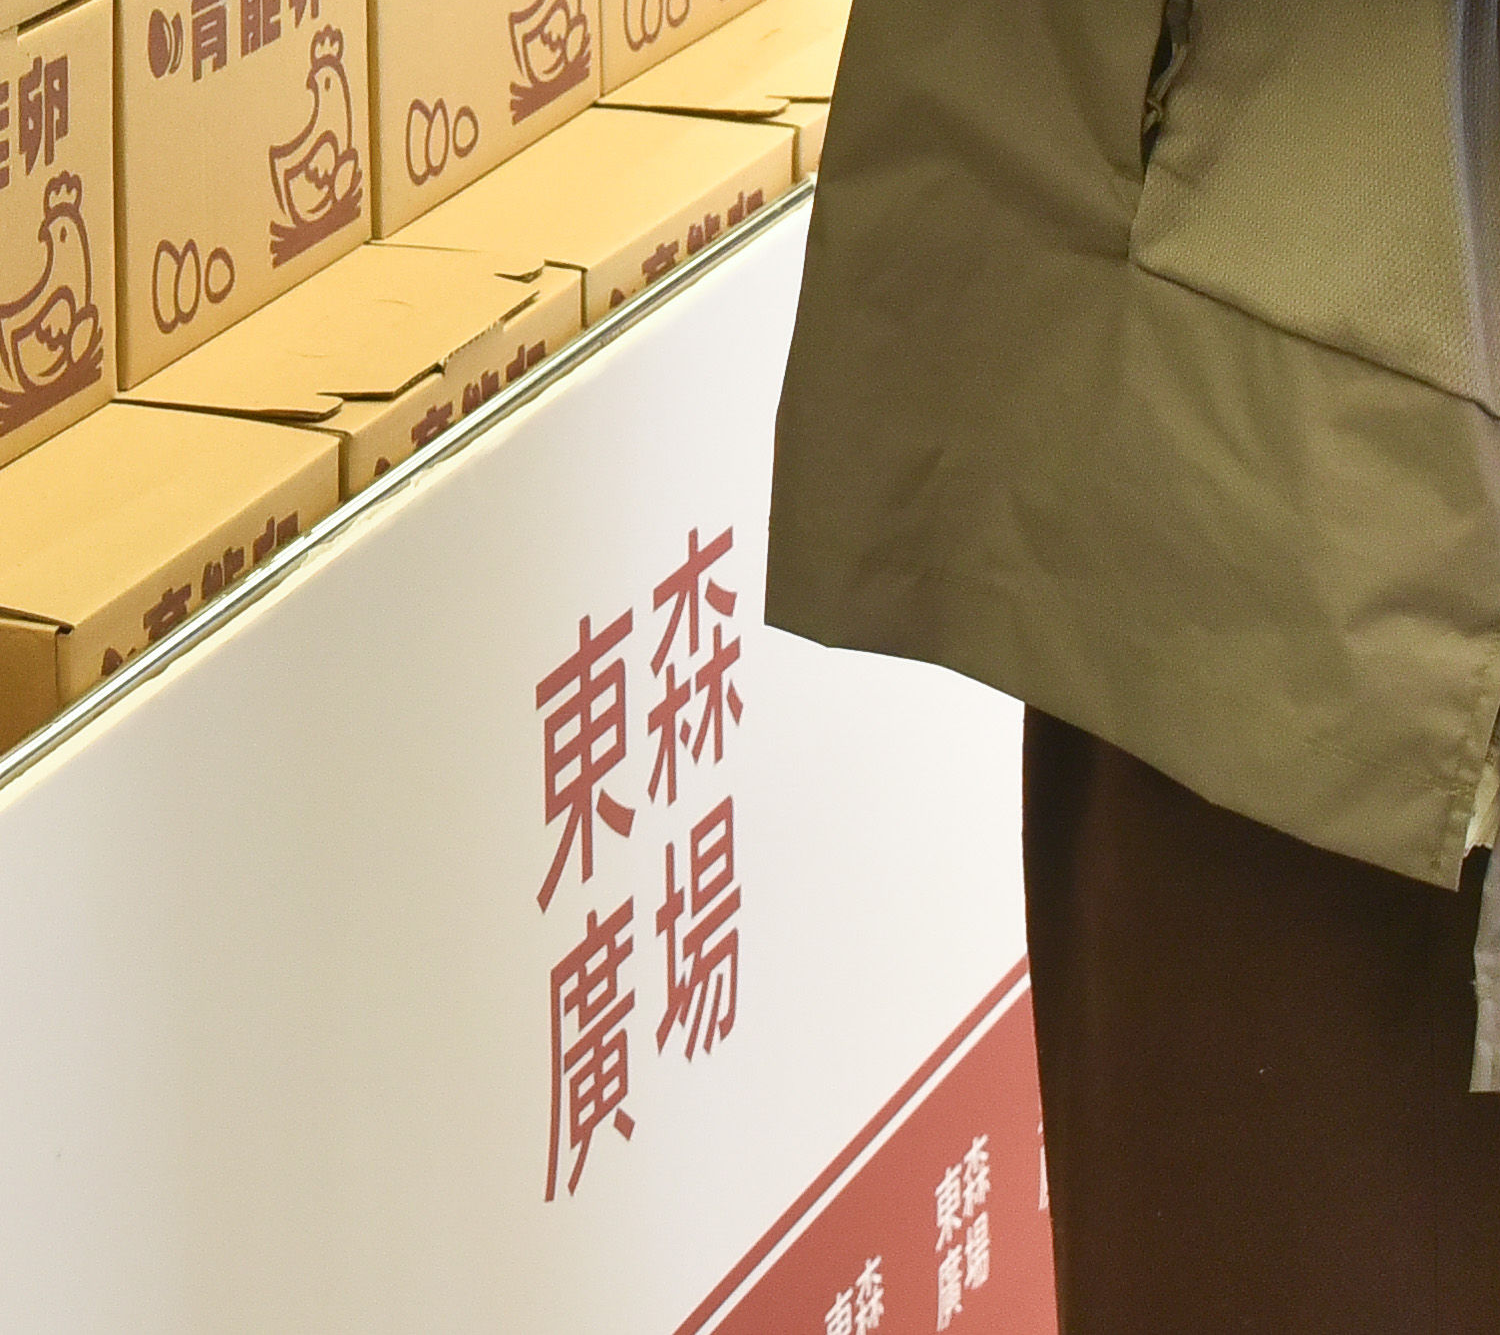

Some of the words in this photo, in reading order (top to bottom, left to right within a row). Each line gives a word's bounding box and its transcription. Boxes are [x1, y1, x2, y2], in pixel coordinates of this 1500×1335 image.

[535, 526, 744, 914] 東森
[544, 794, 742, 1203] 廣場
[934, 1133, 992, 1252] 東森
